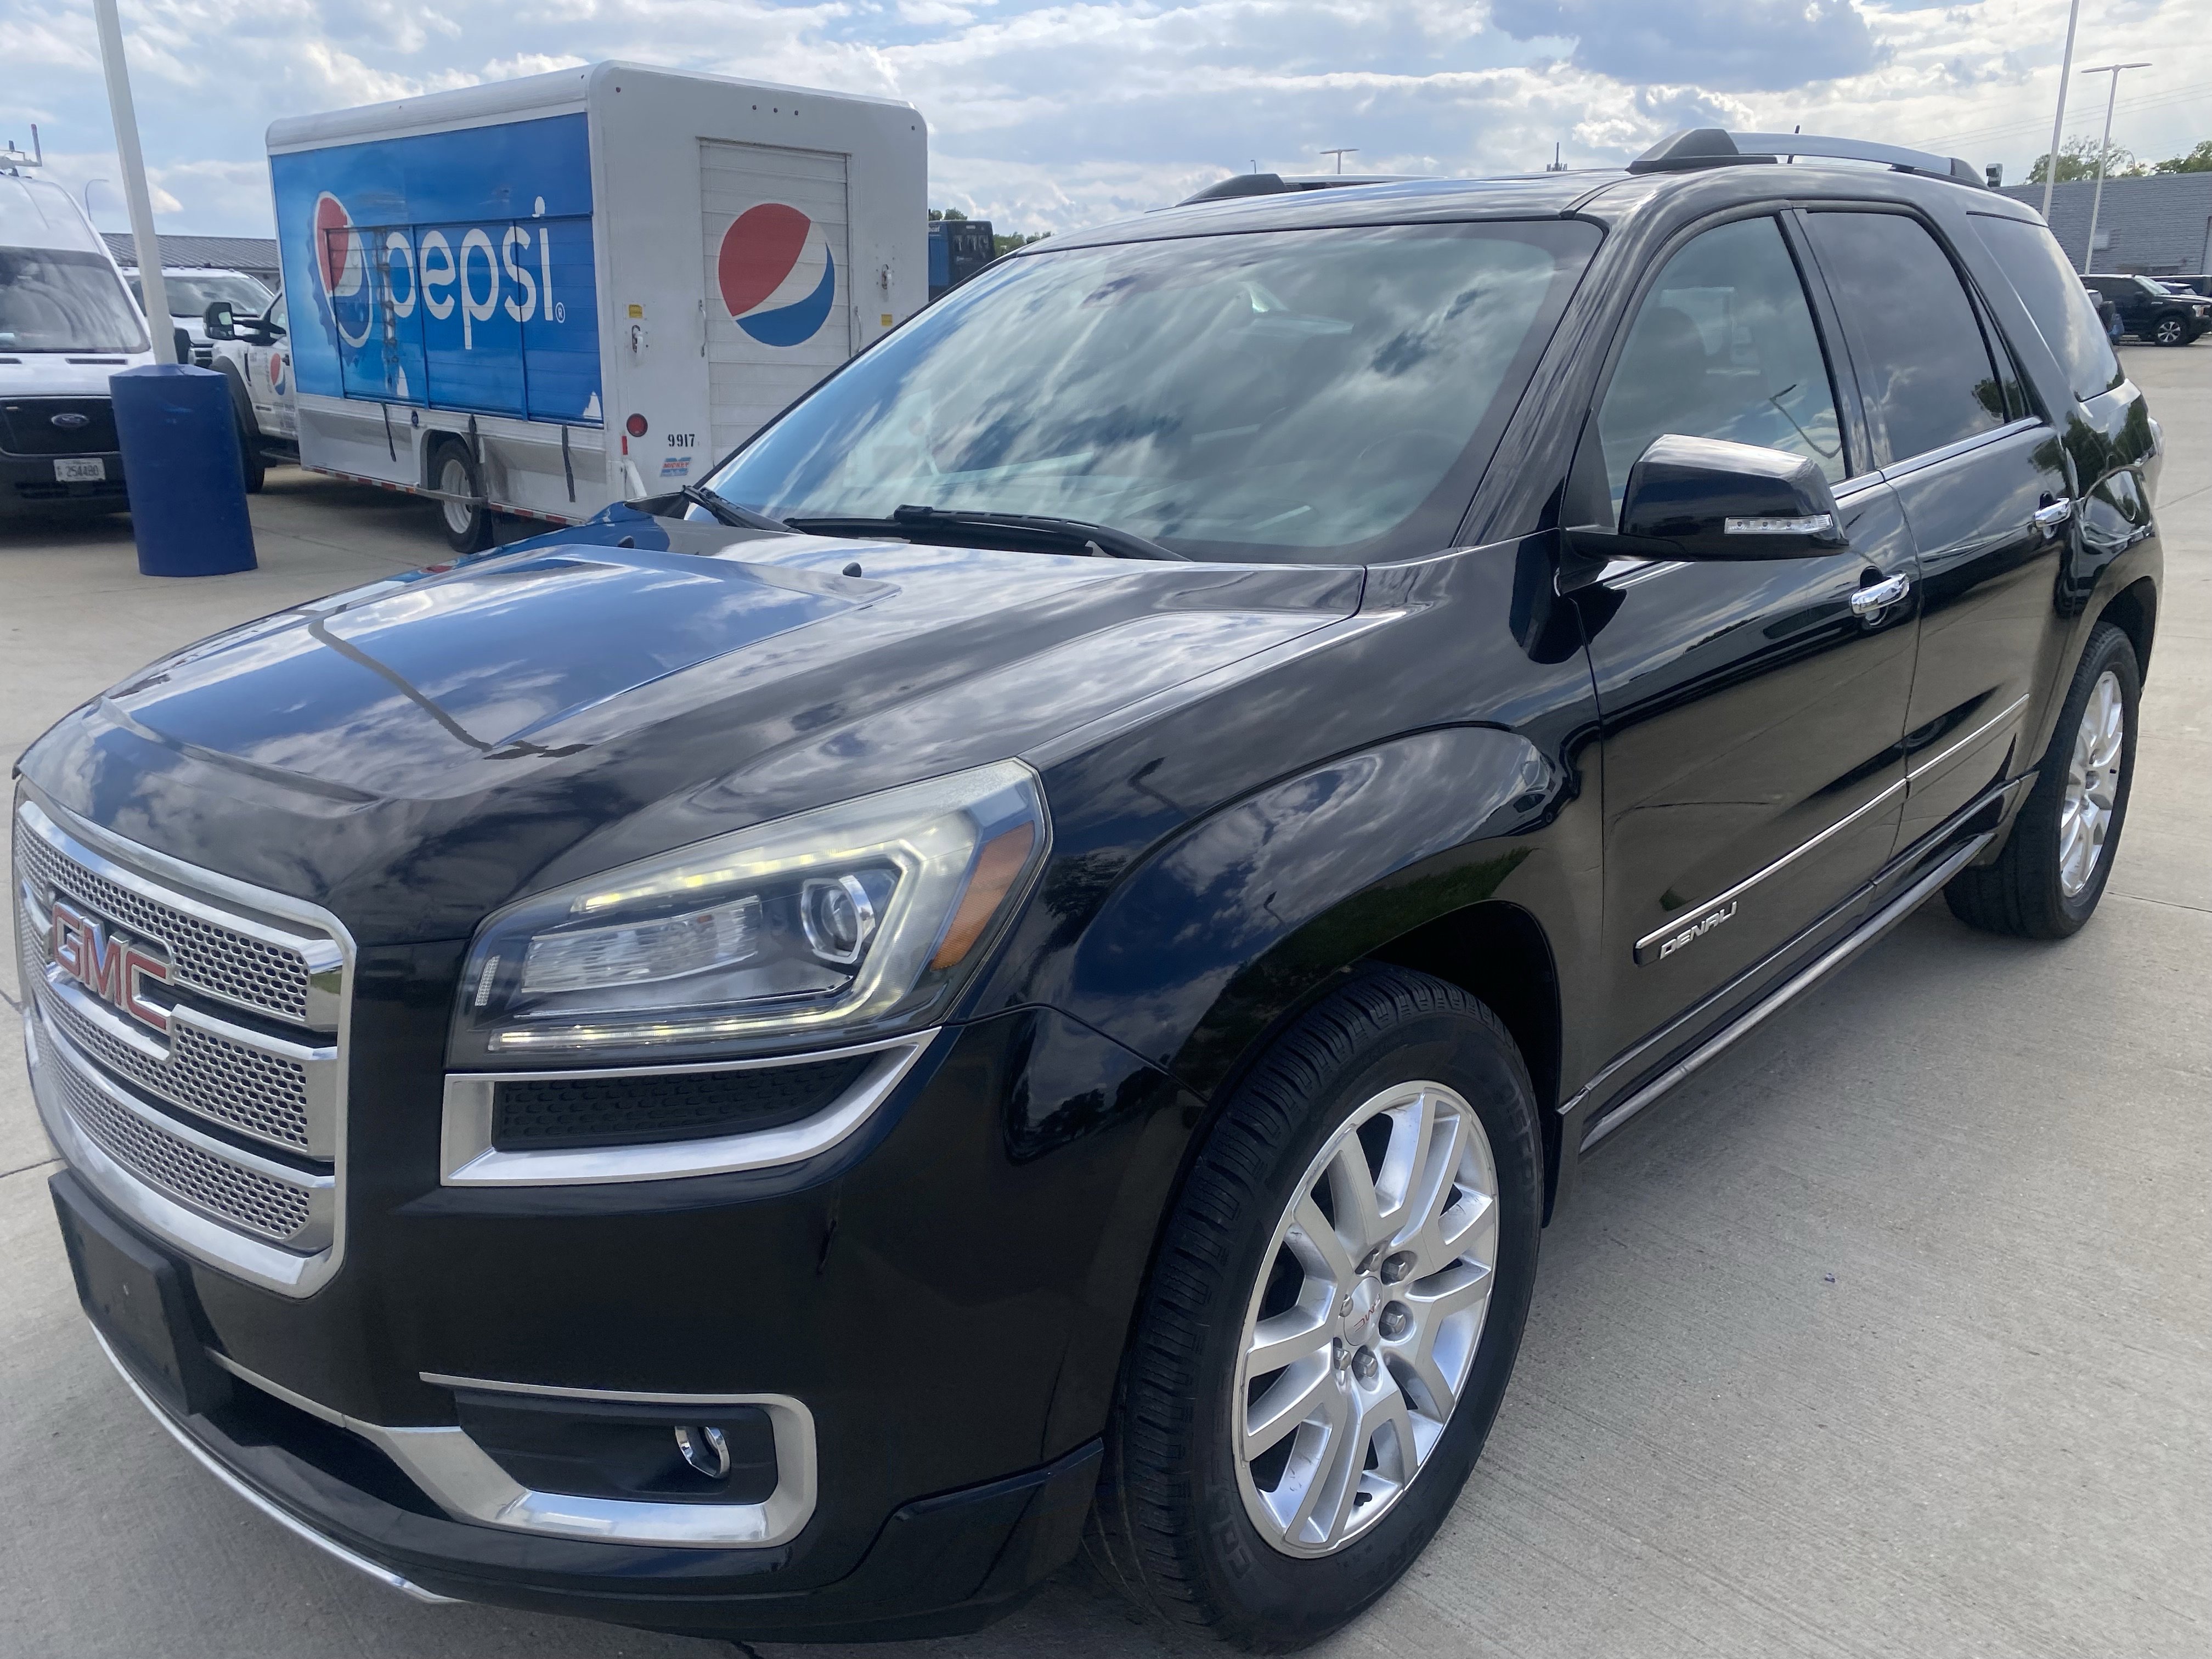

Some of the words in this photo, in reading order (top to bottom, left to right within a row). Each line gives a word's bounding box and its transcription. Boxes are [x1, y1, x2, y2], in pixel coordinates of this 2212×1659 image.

[386, 195, 554, 350] pepsi
[668, 433, 695, 447] 9917
[1660, 901, 1738, 960] DENALI
[52, 901, 175, 1037] GMC
[1353, 1293, 1381, 1333] GMC
